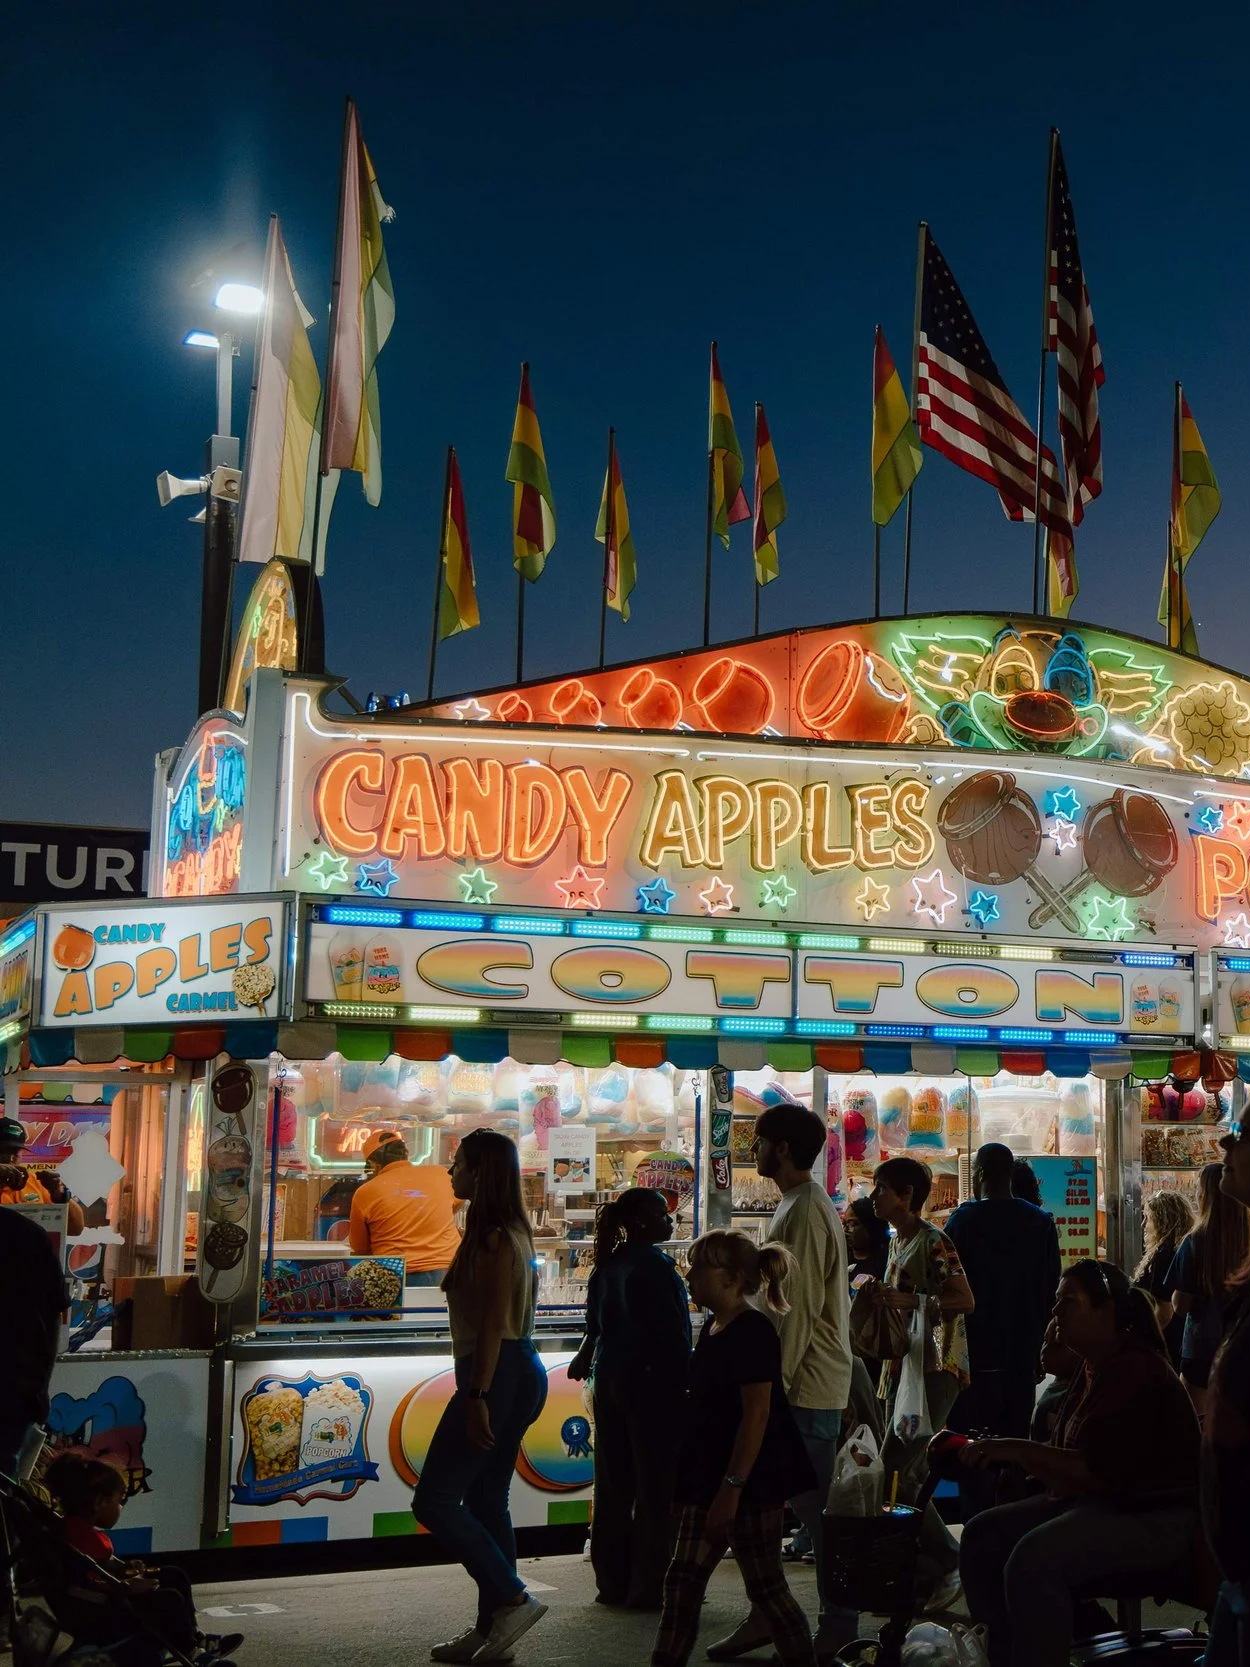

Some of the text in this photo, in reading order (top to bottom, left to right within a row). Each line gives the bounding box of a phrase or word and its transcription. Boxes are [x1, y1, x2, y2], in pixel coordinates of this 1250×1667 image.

[313, 748, 936, 876] CANDY APPLES
[93, 922, 166, 945] CANDY
[53, 916, 273, 1018] APPLES
[416, 938, 1125, 1025] COTTON
[166, 990, 239, 1014] CARMEL
[650, 1158, 688, 1171] CANDY
[716, 1158, 727, 1184] Coke
[636, 1170, 693, 1193] APPLES
[277, 1279, 366, 1313] APPLES
[306, 1445, 348, 1458] POPCORN
